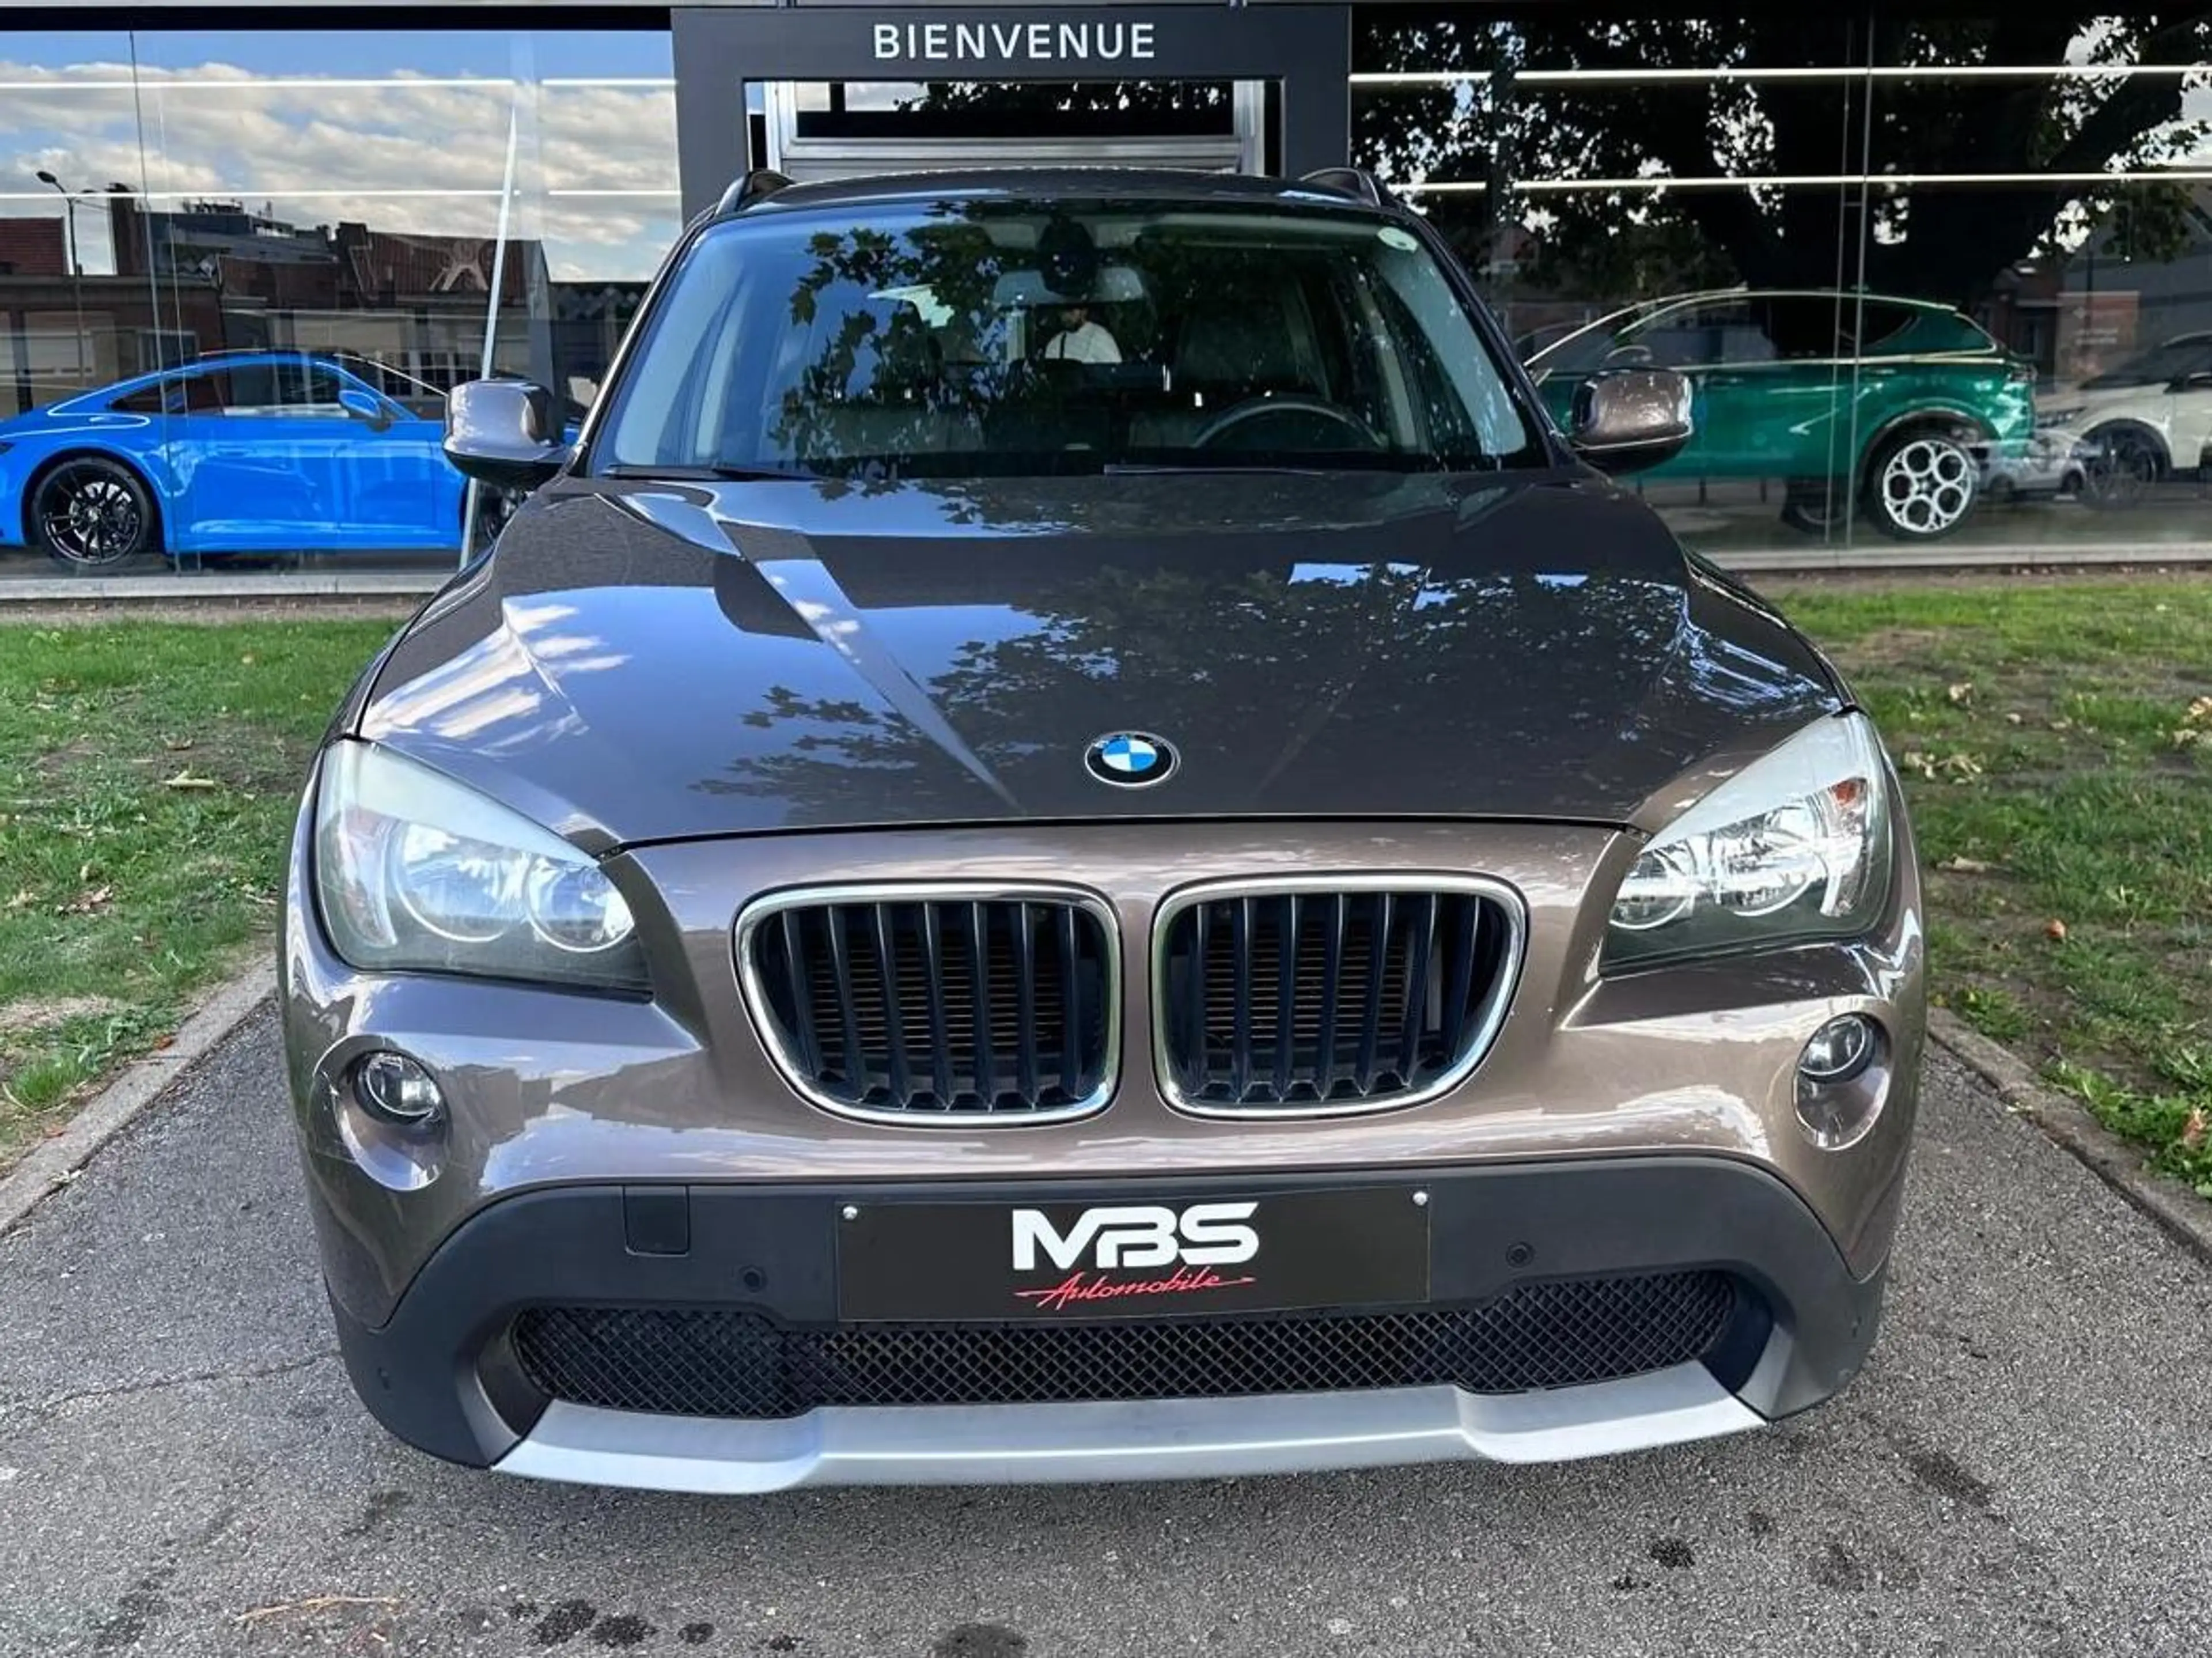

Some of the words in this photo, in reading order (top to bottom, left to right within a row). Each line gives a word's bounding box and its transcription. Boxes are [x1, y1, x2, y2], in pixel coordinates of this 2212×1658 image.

[873, 23, 1155, 59] BIENVENUE
[1012, 1201, 1260, 1270] MBS
[1015, 1266, 1257, 1310] Automobile
